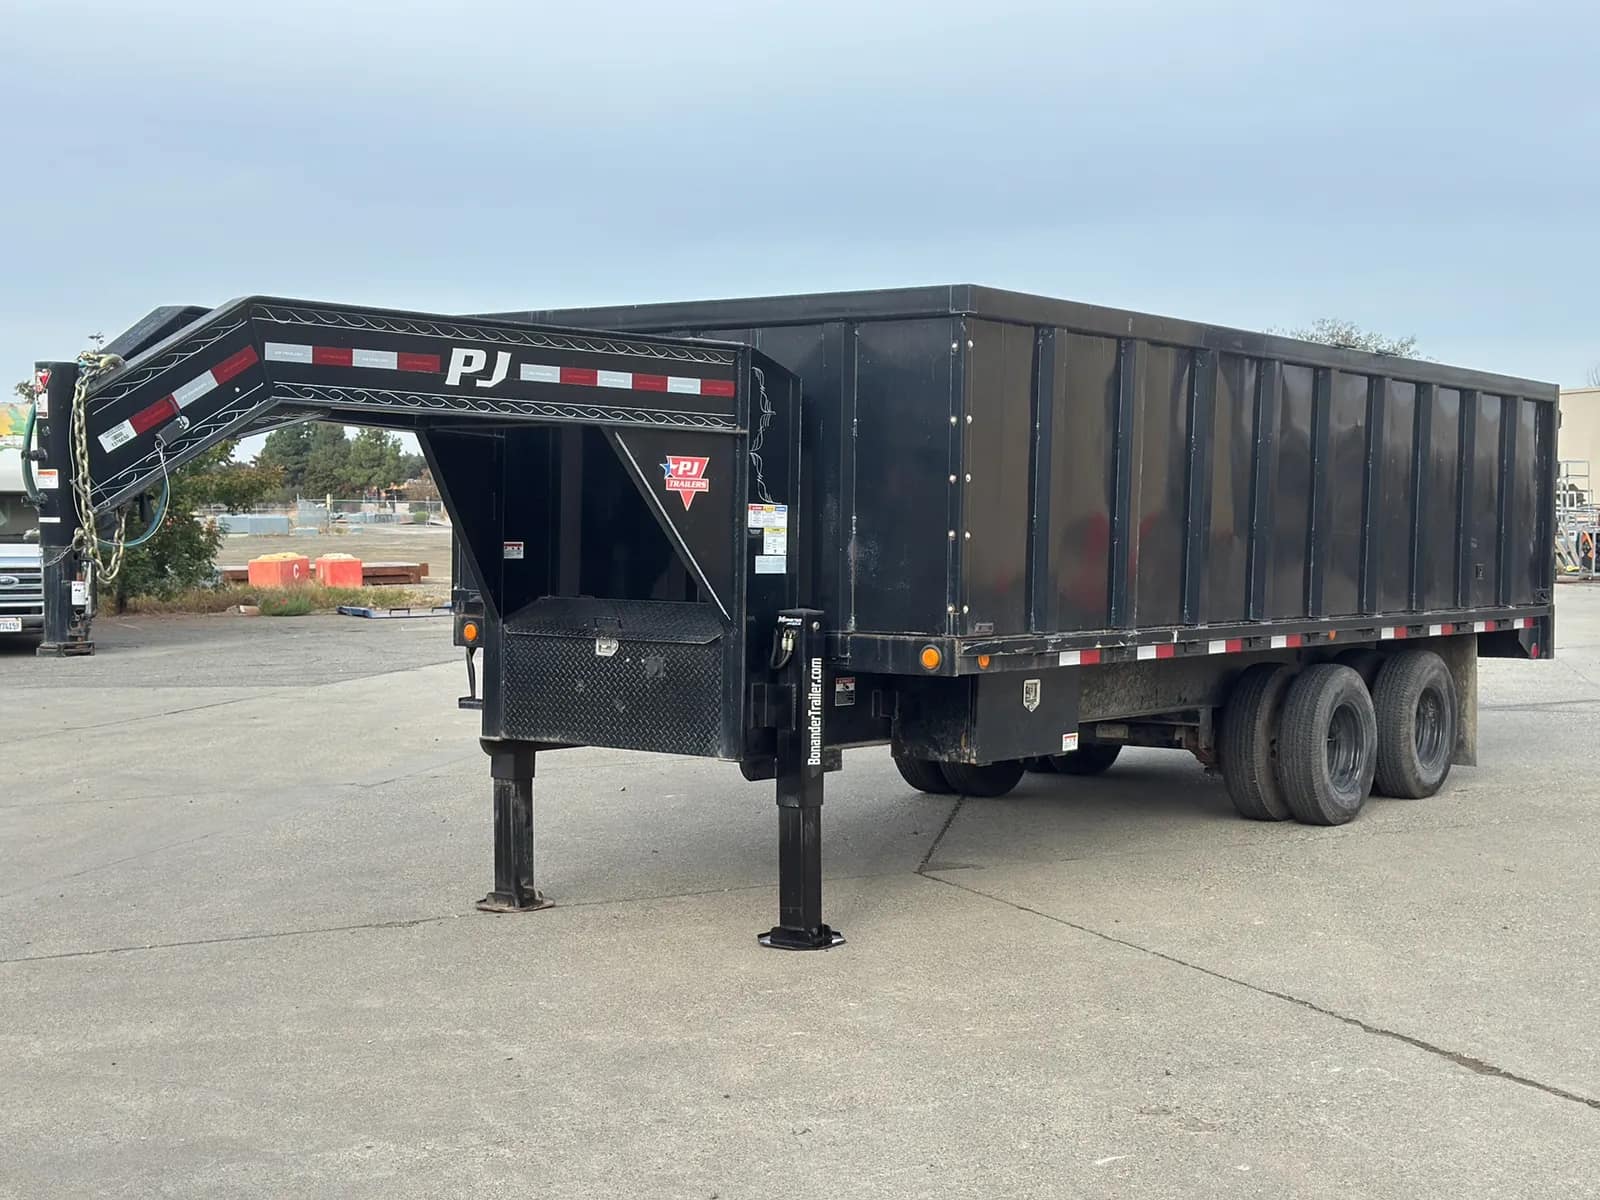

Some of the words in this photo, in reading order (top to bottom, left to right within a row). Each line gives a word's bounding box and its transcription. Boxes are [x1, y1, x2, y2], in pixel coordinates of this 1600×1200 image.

[445, 348, 512, 388] PJ
[677, 461, 700, 476] PJ
[669, 479, 706, 489] TRAILERS
[808, 657, 823, 766] BonanderTrailer.com
